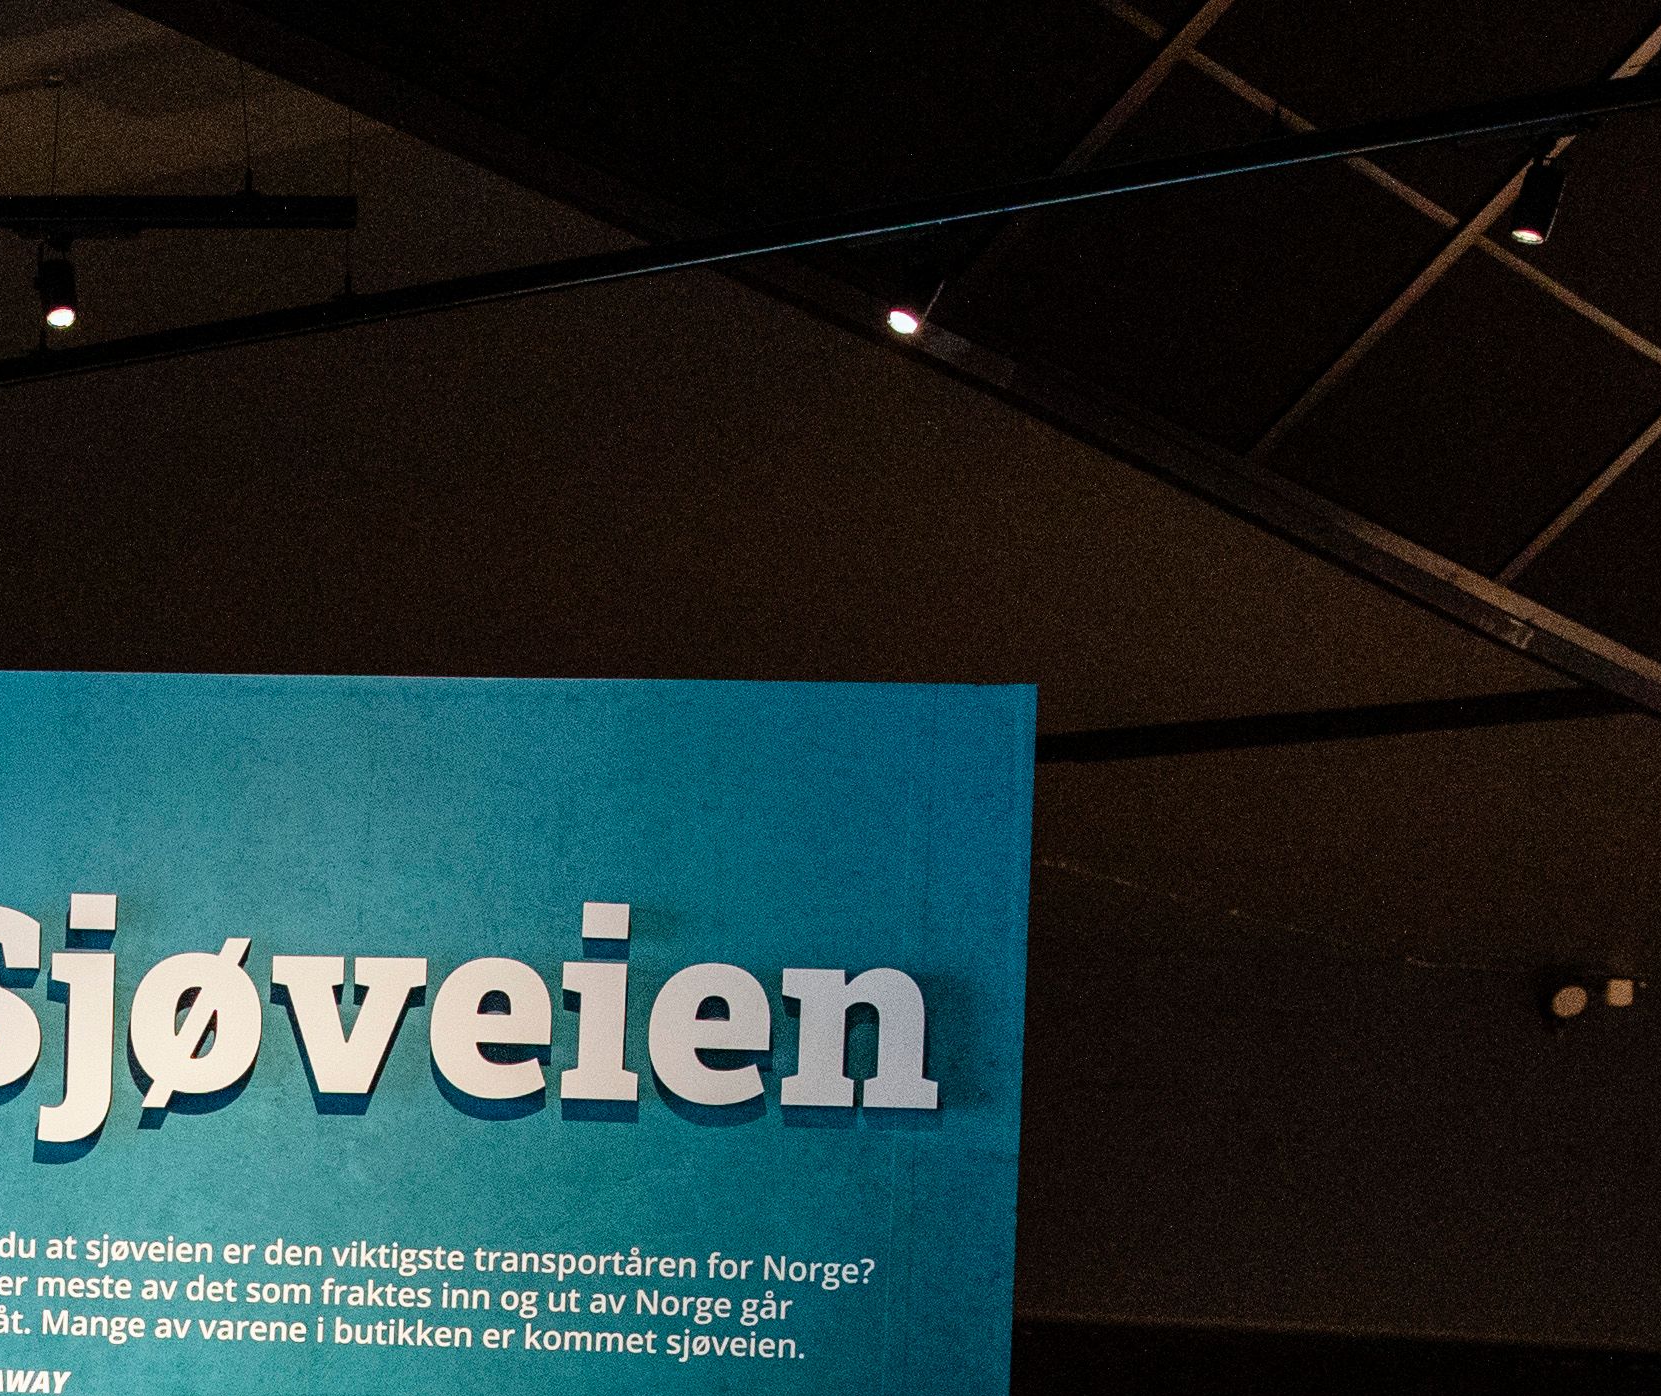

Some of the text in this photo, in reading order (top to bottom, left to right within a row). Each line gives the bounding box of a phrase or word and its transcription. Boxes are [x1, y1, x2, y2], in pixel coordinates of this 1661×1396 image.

[45, 1235, 78, 1261] at
[85, 1232, 214, 1269] sjøveien
[222, 1242, 256, 1265] er
[263, 1237, 323, 1267] den
[331, 1239, 466, 1280] viktigste
[473, 1245, 697, 1283] transportåren
[707, 1250, 754, 1281] for
[763, 1254, 876, 1292] Norge?
[36, 1273, 133, 1301] meste
[140, 1278, 179, 1302] av
[185, 1273, 238, 1304] det
[245, 1281, 312, 1305] som
[320, 1276, 432, 1309] fraktes
[441, 1280, 491, 1311] inn
[499, 1289, 539, 1320] og
[547, 1288, 581, 1314] ut
[589, 1291, 627, 1315] av
[635, 1288, 732, 1326] Norge
[739, 1289, 793, 1328] går
[41, 1307, 146, 1346] Mange
[153, 1317, 192, 1340] av
[198, 1318, 308, 1344] varene
[316, 1316, 325, 1344] i
[333, 1315, 473, 1349] butikken
[481, 1327, 516, 1350] er
[524, 1322, 657, 1355] kommet
[666, 1328, 805, 1364] sjøveien.
